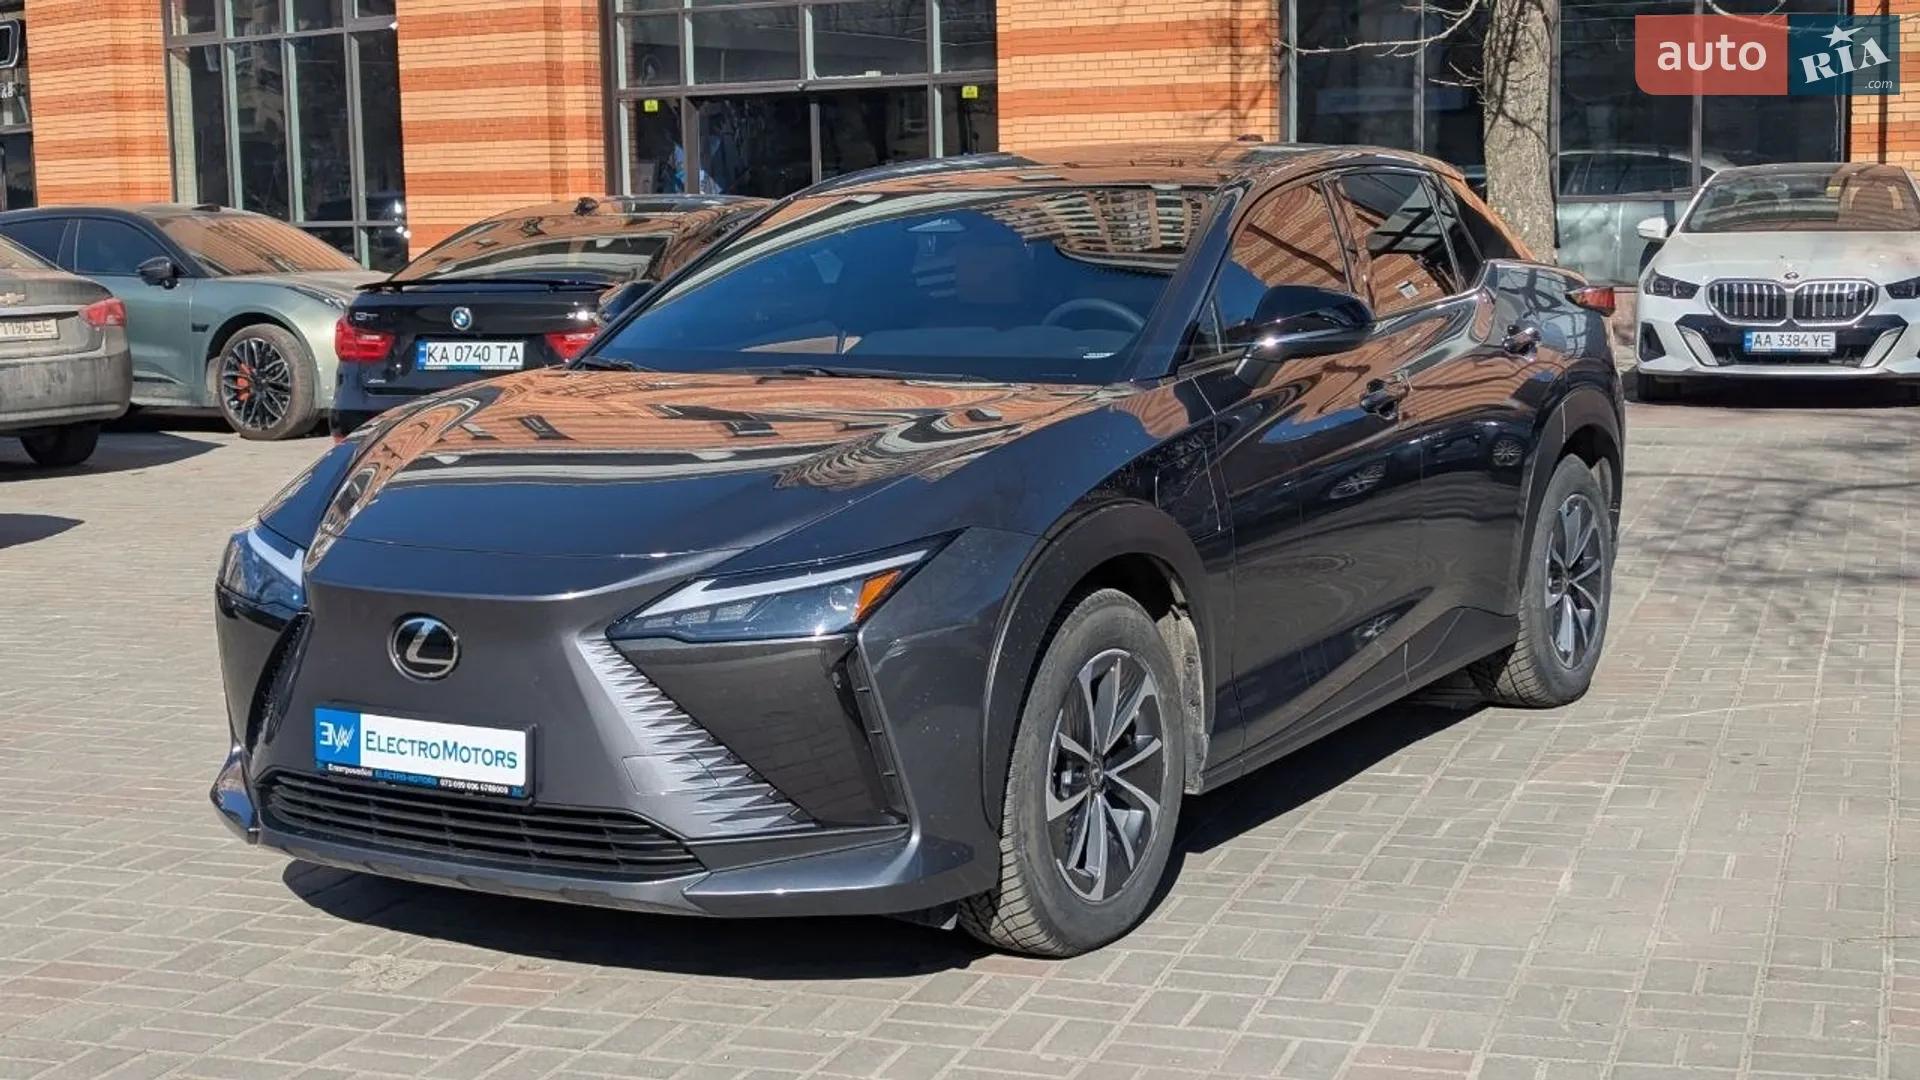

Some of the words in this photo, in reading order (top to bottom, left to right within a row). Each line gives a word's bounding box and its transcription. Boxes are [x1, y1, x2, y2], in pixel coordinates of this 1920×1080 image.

[1754, 333, 1772, 347] AA
[1777, 333, 1809, 347] 3384
[1812, 333, 1832, 347] YE
[427, 345, 449, 363] KA
[454, 345, 491, 362] 0740
[496, 345, 519, 363] TA
